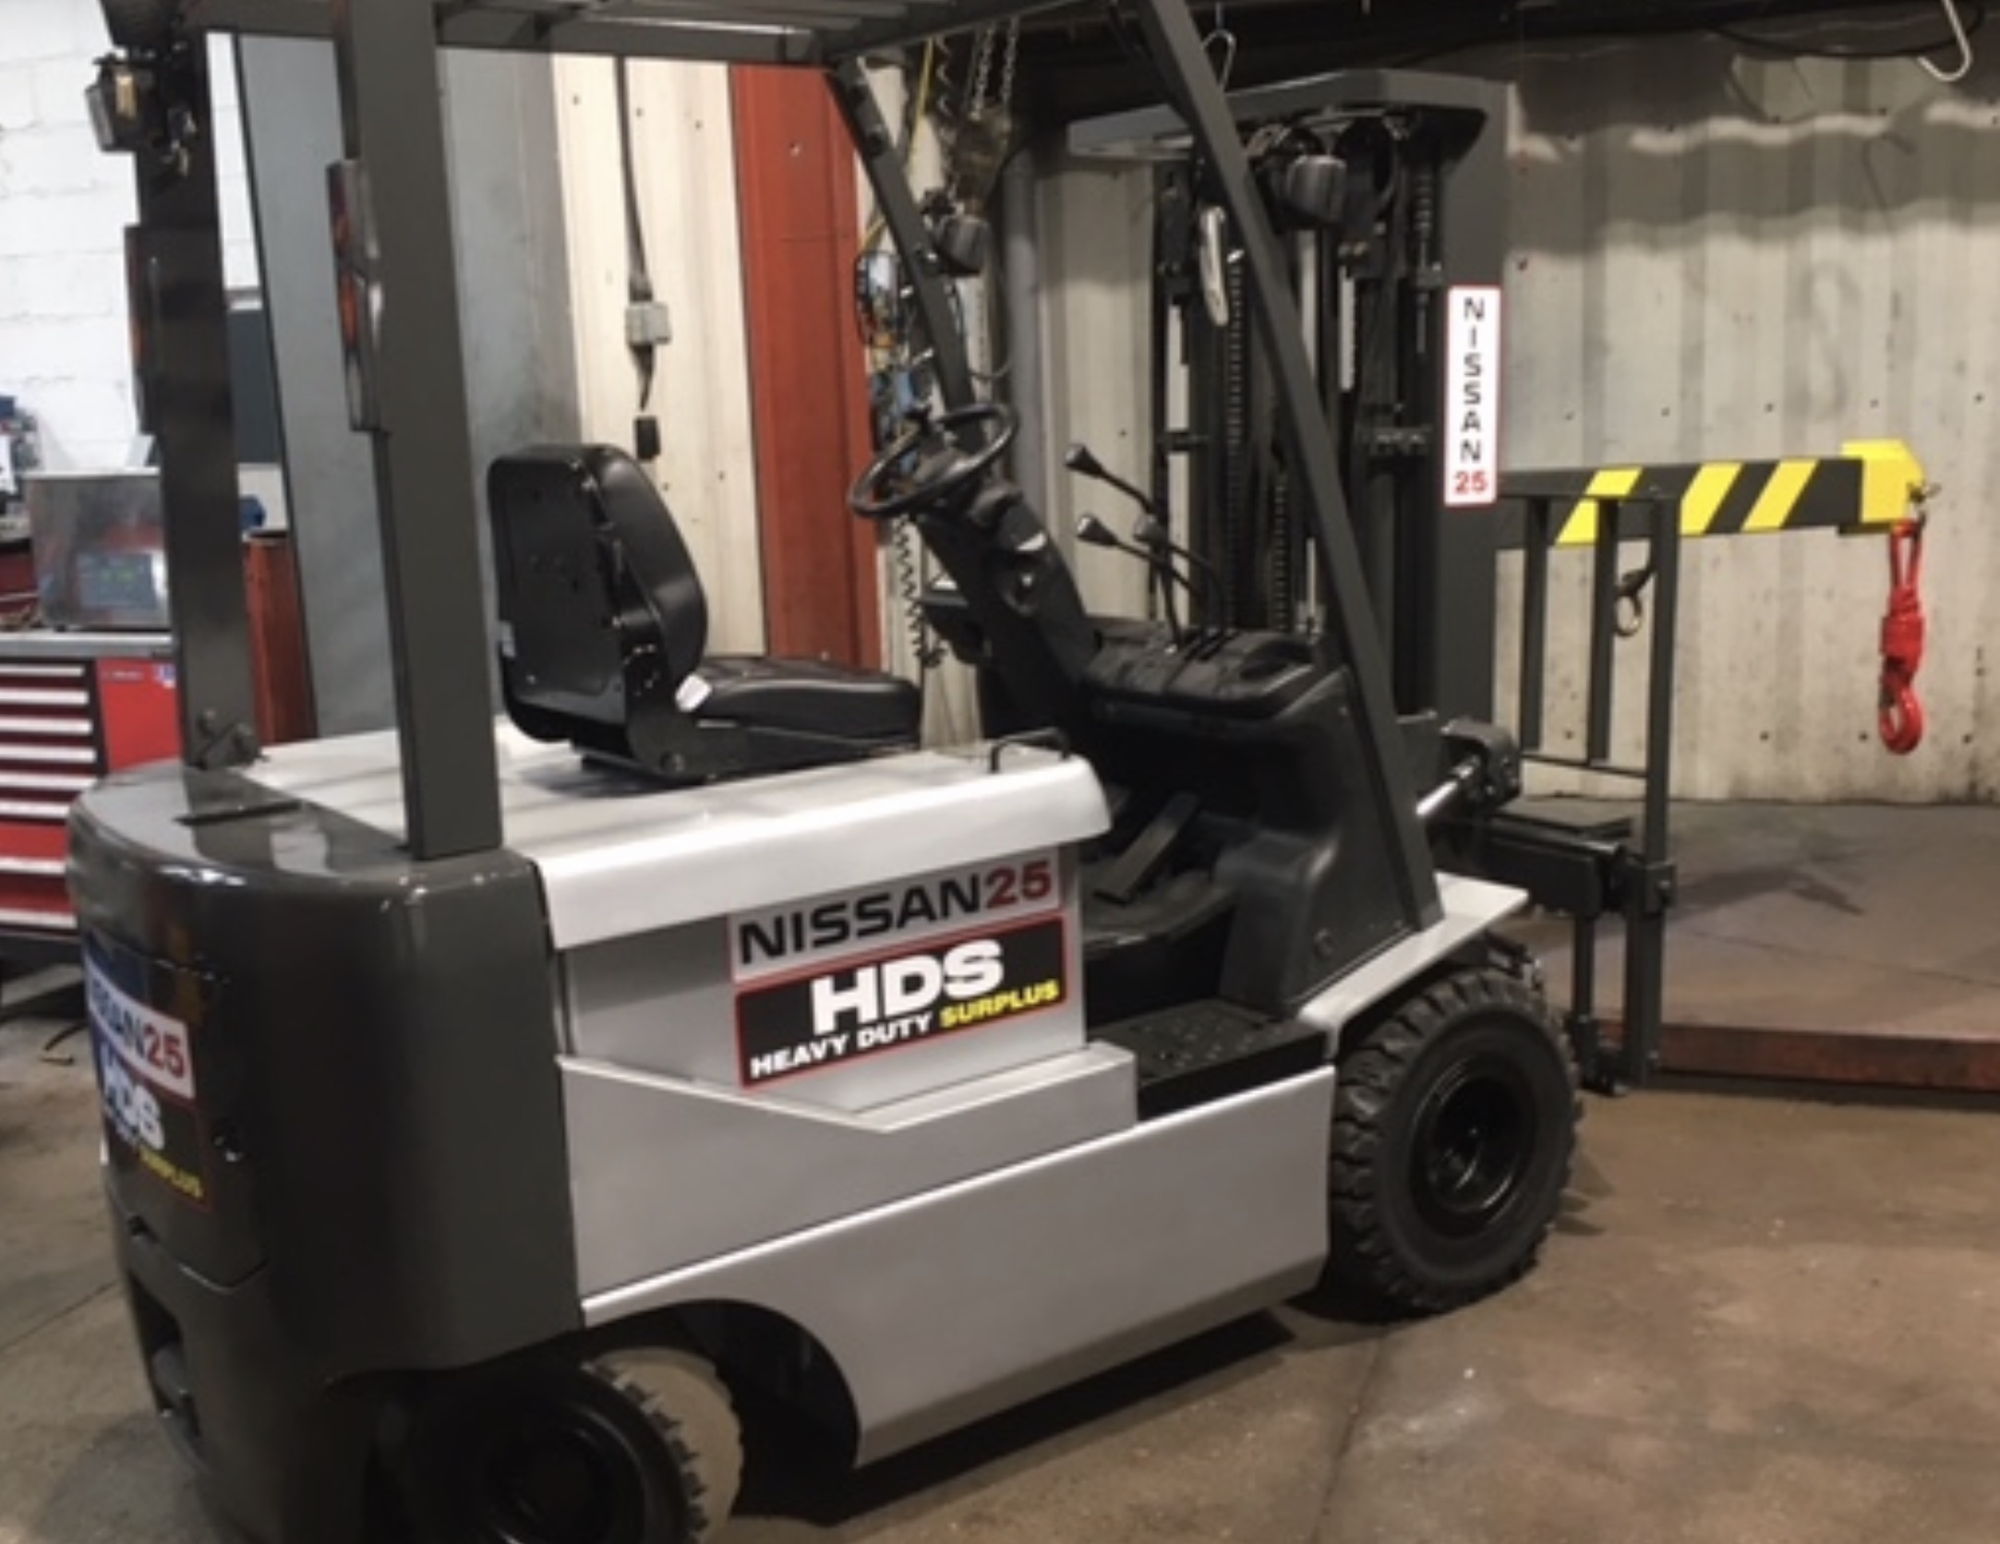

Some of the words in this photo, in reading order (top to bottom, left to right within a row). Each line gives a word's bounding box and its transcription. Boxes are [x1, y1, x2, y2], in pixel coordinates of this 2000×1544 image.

[1460, 296, 1486, 463] NISSAN
[1454, 470, 1489, 494] 25
[751, 1032, 850, 1078] HEAVY
[856, 1012, 933, 1049] DUTY
[939, 978, 1060, 1029] SURPLUS
[810, 938, 1004, 1036] HDS
